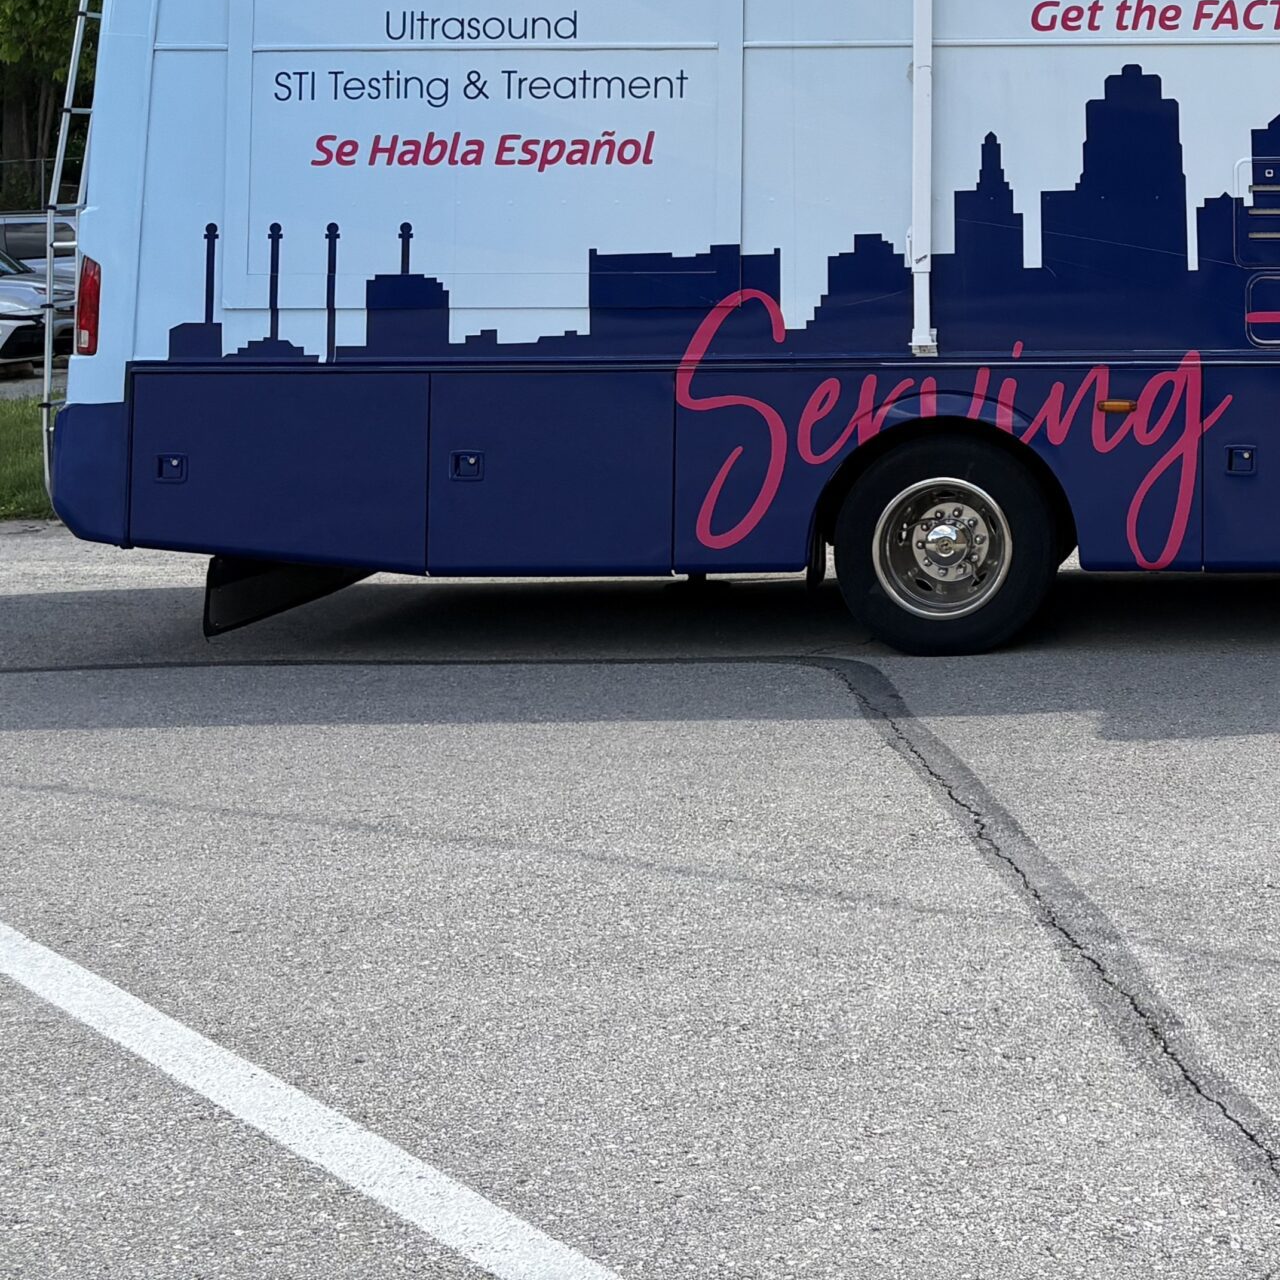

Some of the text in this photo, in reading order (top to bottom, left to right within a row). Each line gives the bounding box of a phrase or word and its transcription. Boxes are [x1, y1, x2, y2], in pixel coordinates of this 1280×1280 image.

[385, 9, 578, 41] Ultrasound
[1030, 0, 1104, 32] Get
[274, 69, 690, 108] STI Testing & Treatment
[310, 130, 656, 173] Se Habla Español
[675, 288, 1234, 571] Serving
